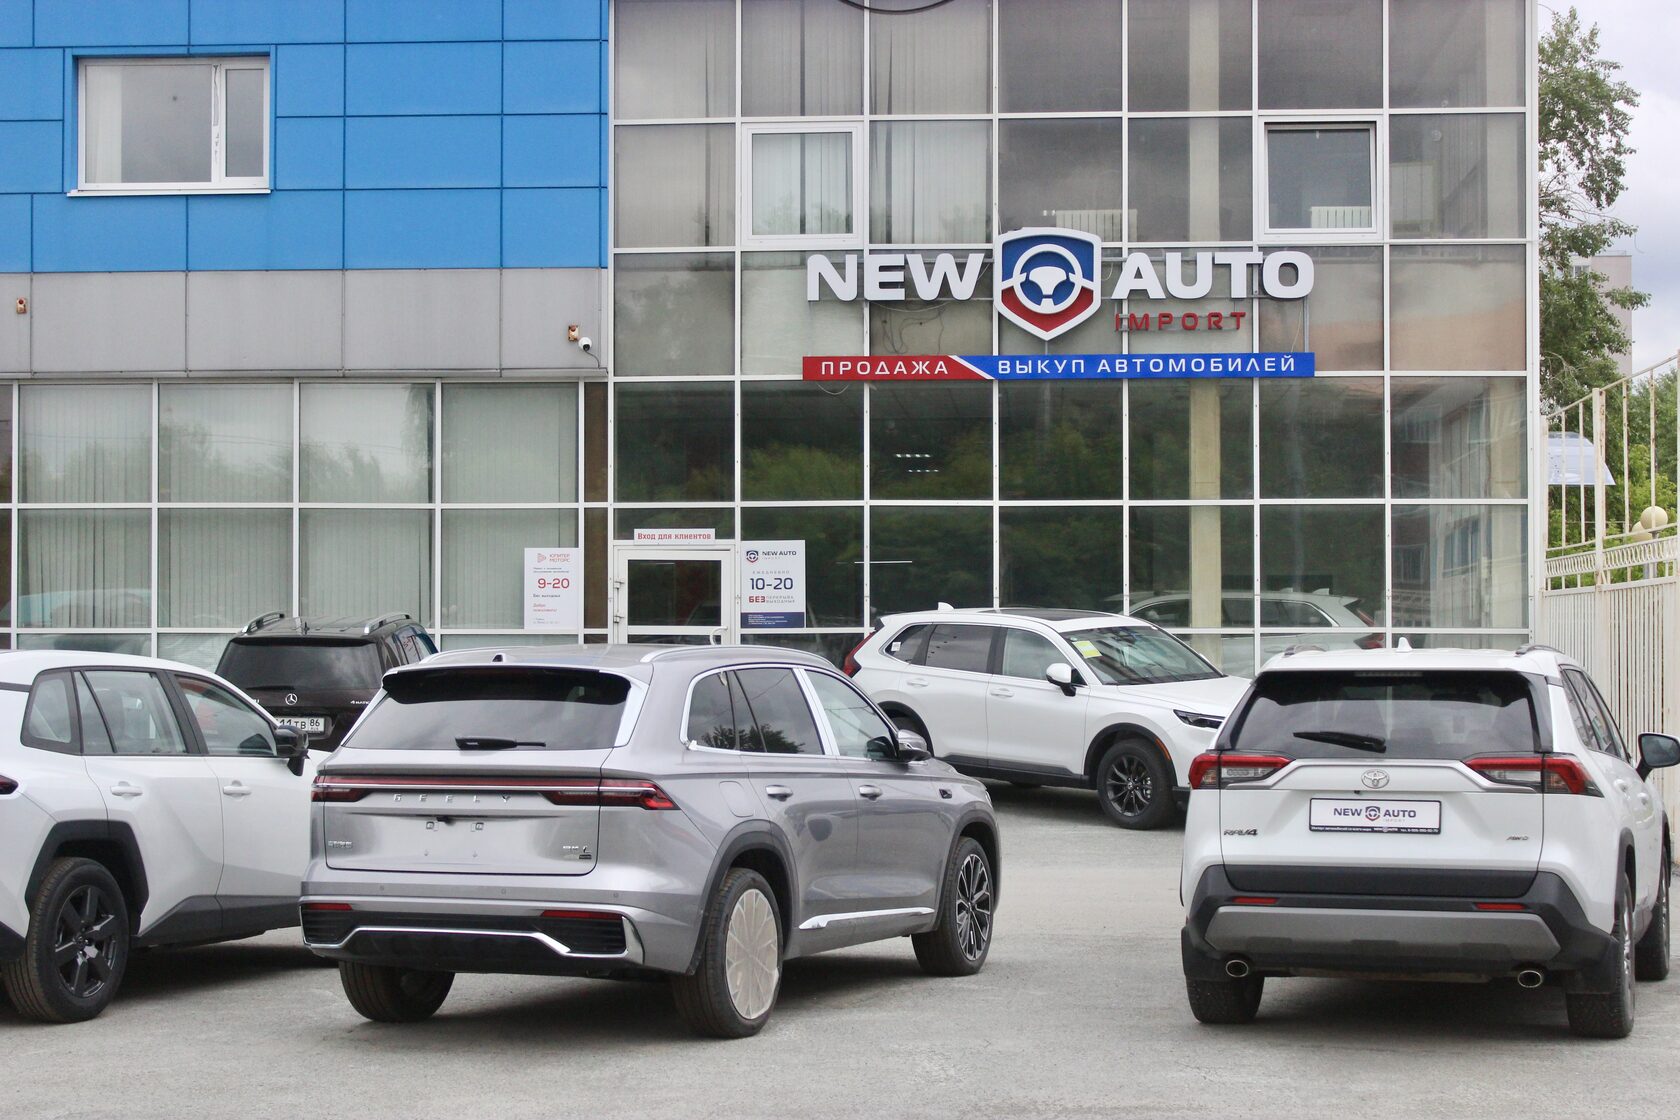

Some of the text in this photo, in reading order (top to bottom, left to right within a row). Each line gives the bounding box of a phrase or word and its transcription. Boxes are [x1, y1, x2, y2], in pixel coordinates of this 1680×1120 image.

[806, 250, 1315, 301] NEW AUTO
[1115, 312, 1246, 331] IMPORT
[821, 360, 948, 375] ПРОДАЖА
[998, 355, 1295, 374] ВЫКУП АВТОМОБИЛЕЙ
[637, 532, 656, 540] Вход
[674, 532, 712, 540] клиентов
[537, 577, 570, 589] 9-20
[750, 577, 794, 590] 10-20
[748, 595, 766, 603] БЕЗ
[309, 718, 321, 727] 86
[393, 793, 511, 803] GEELY
[1333, 807, 1417, 818] NEW AUTO
